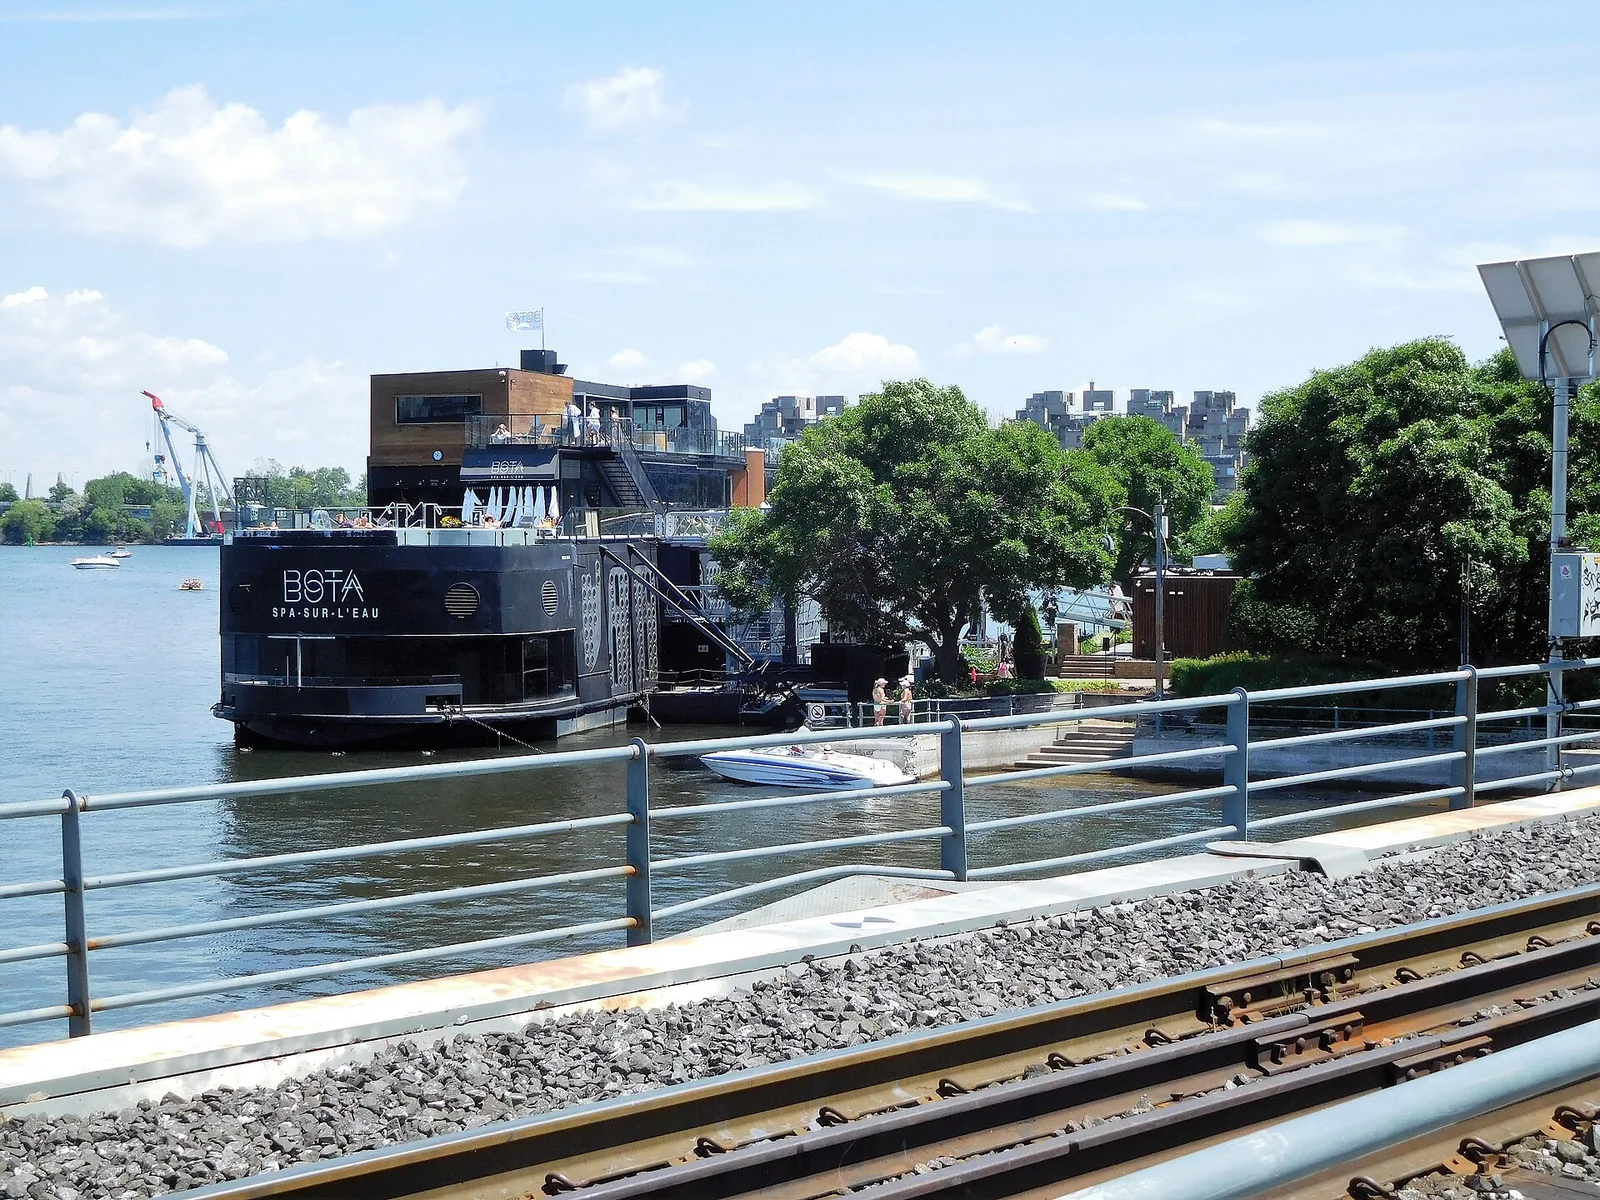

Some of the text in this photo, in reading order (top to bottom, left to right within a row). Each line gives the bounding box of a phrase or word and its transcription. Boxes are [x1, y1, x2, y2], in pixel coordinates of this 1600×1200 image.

[491, 460, 524, 474] BOTA
[283, 569, 364, 603] BOTA
[272, 607, 379, 618] SPA-SUR-L'EAU
